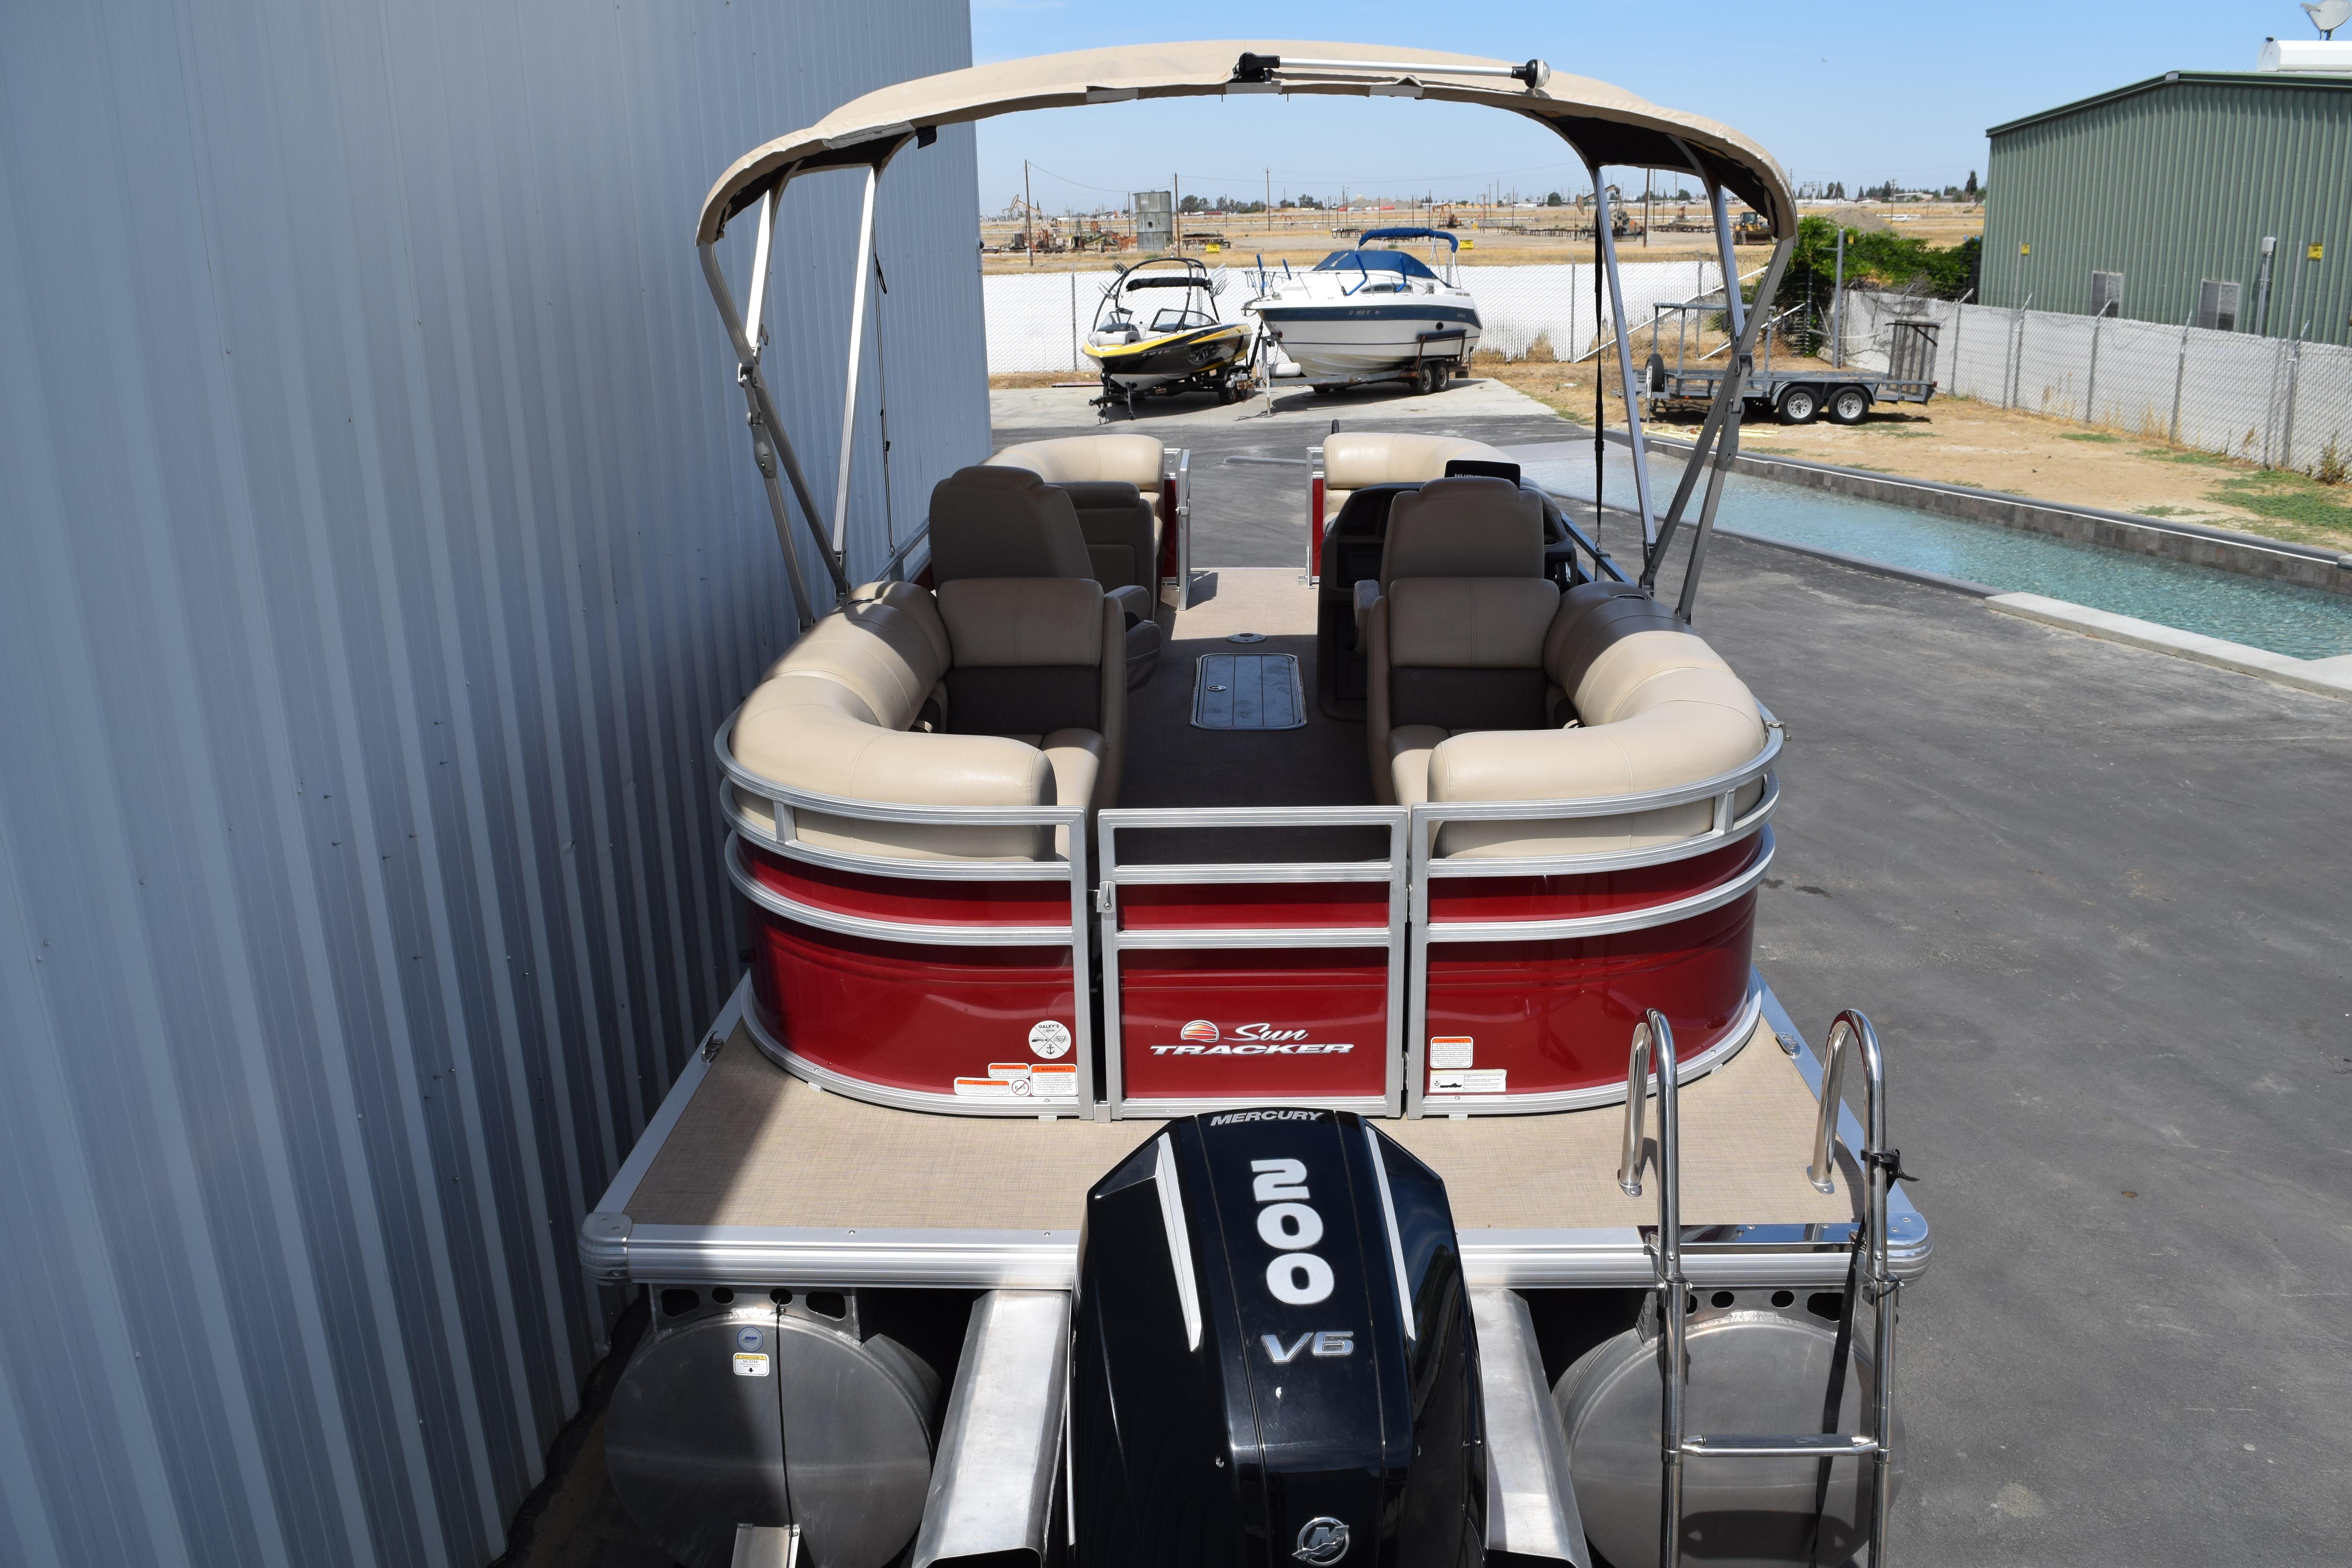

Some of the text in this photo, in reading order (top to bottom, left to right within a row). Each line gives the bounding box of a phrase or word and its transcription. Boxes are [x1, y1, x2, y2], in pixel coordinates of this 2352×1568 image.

[1223, 1023, 1309, 1041] Sun
[1149, 1044, 1354, 1056] TRACKER
[1210, 1111, 1325, 1126] MERCURY
[1250, 1158, 1335, 1305] 200
[1261, 1331, 1354, 1363] V6
